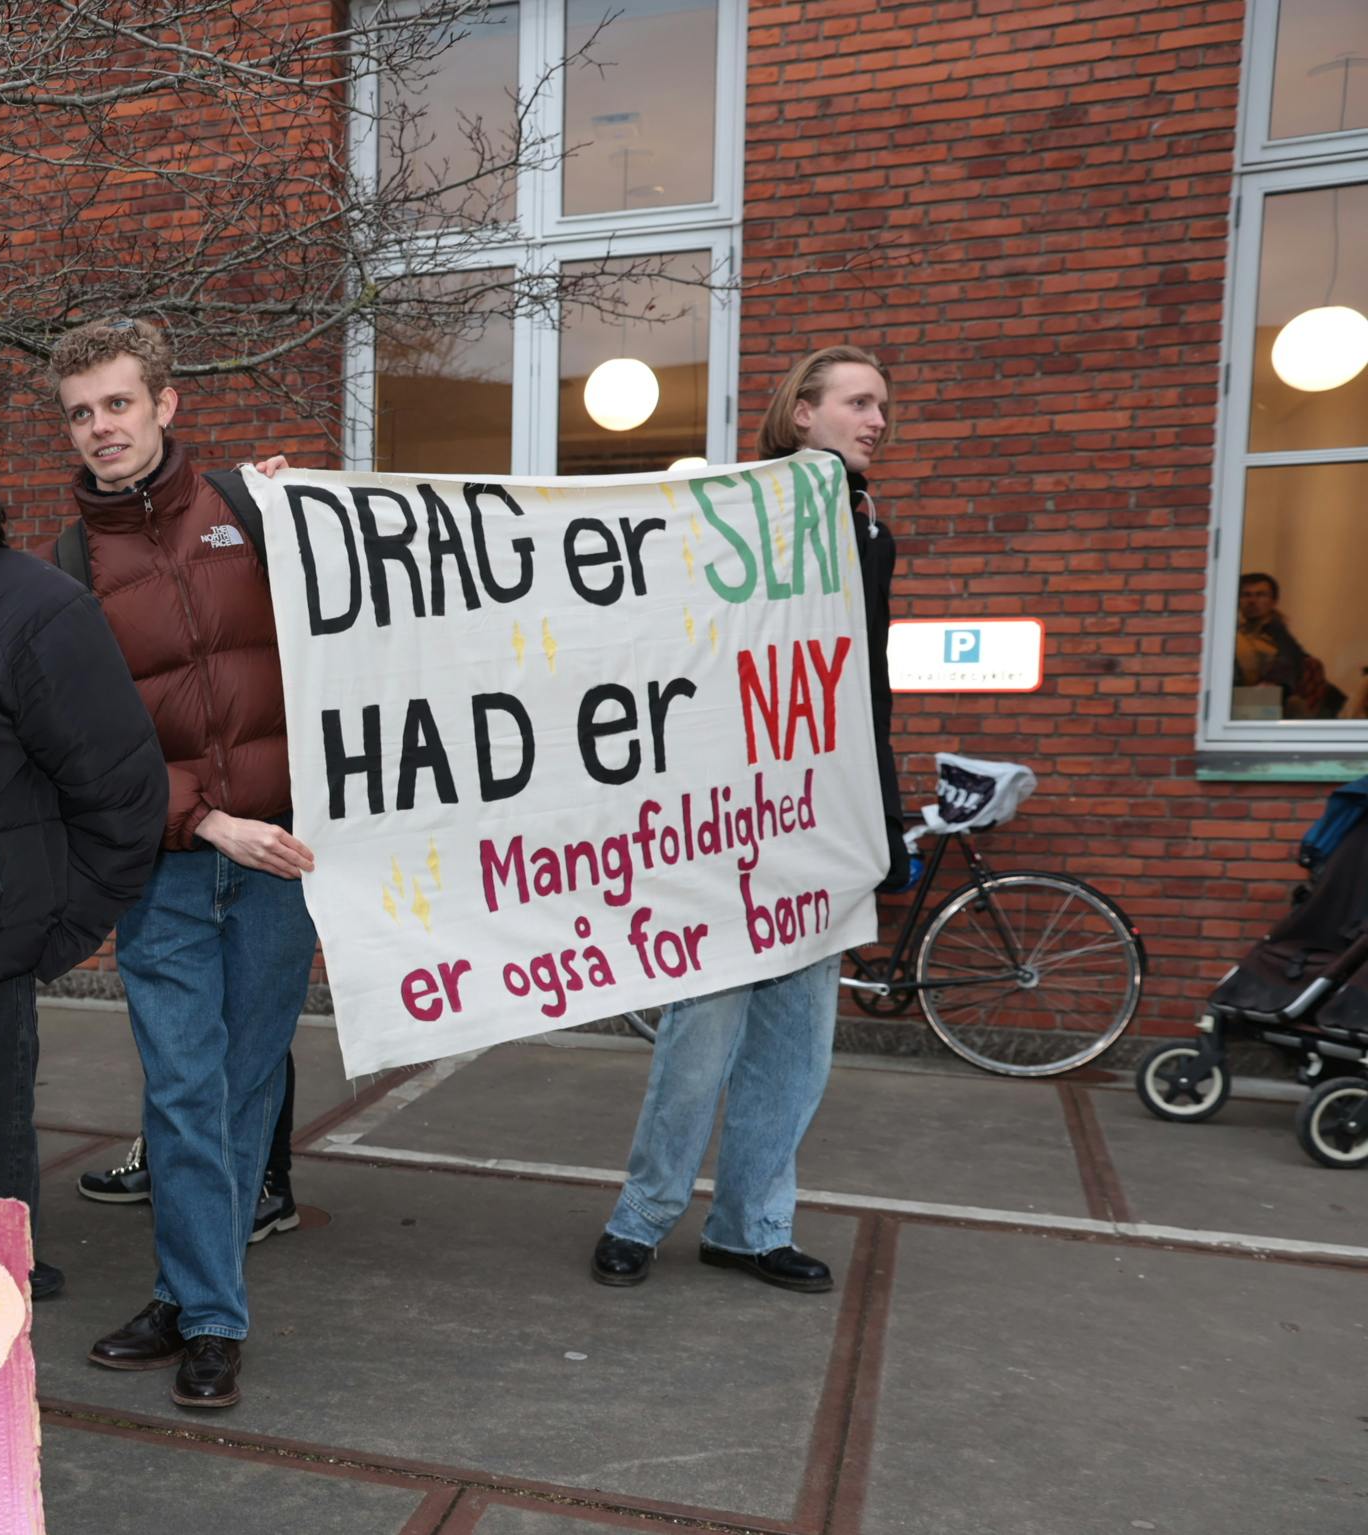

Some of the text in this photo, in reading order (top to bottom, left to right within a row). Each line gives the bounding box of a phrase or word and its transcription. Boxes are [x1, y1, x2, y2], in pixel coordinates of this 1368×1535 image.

[284, 459, 843, 636] DRAG er SLAY
[950, 631, 976, 662] P
[322, 637, 851, 820] HAD er NAY
[479, 769, 816, 912] Mangfoldighed
[401, 872, 829, 1022] er også for børn
